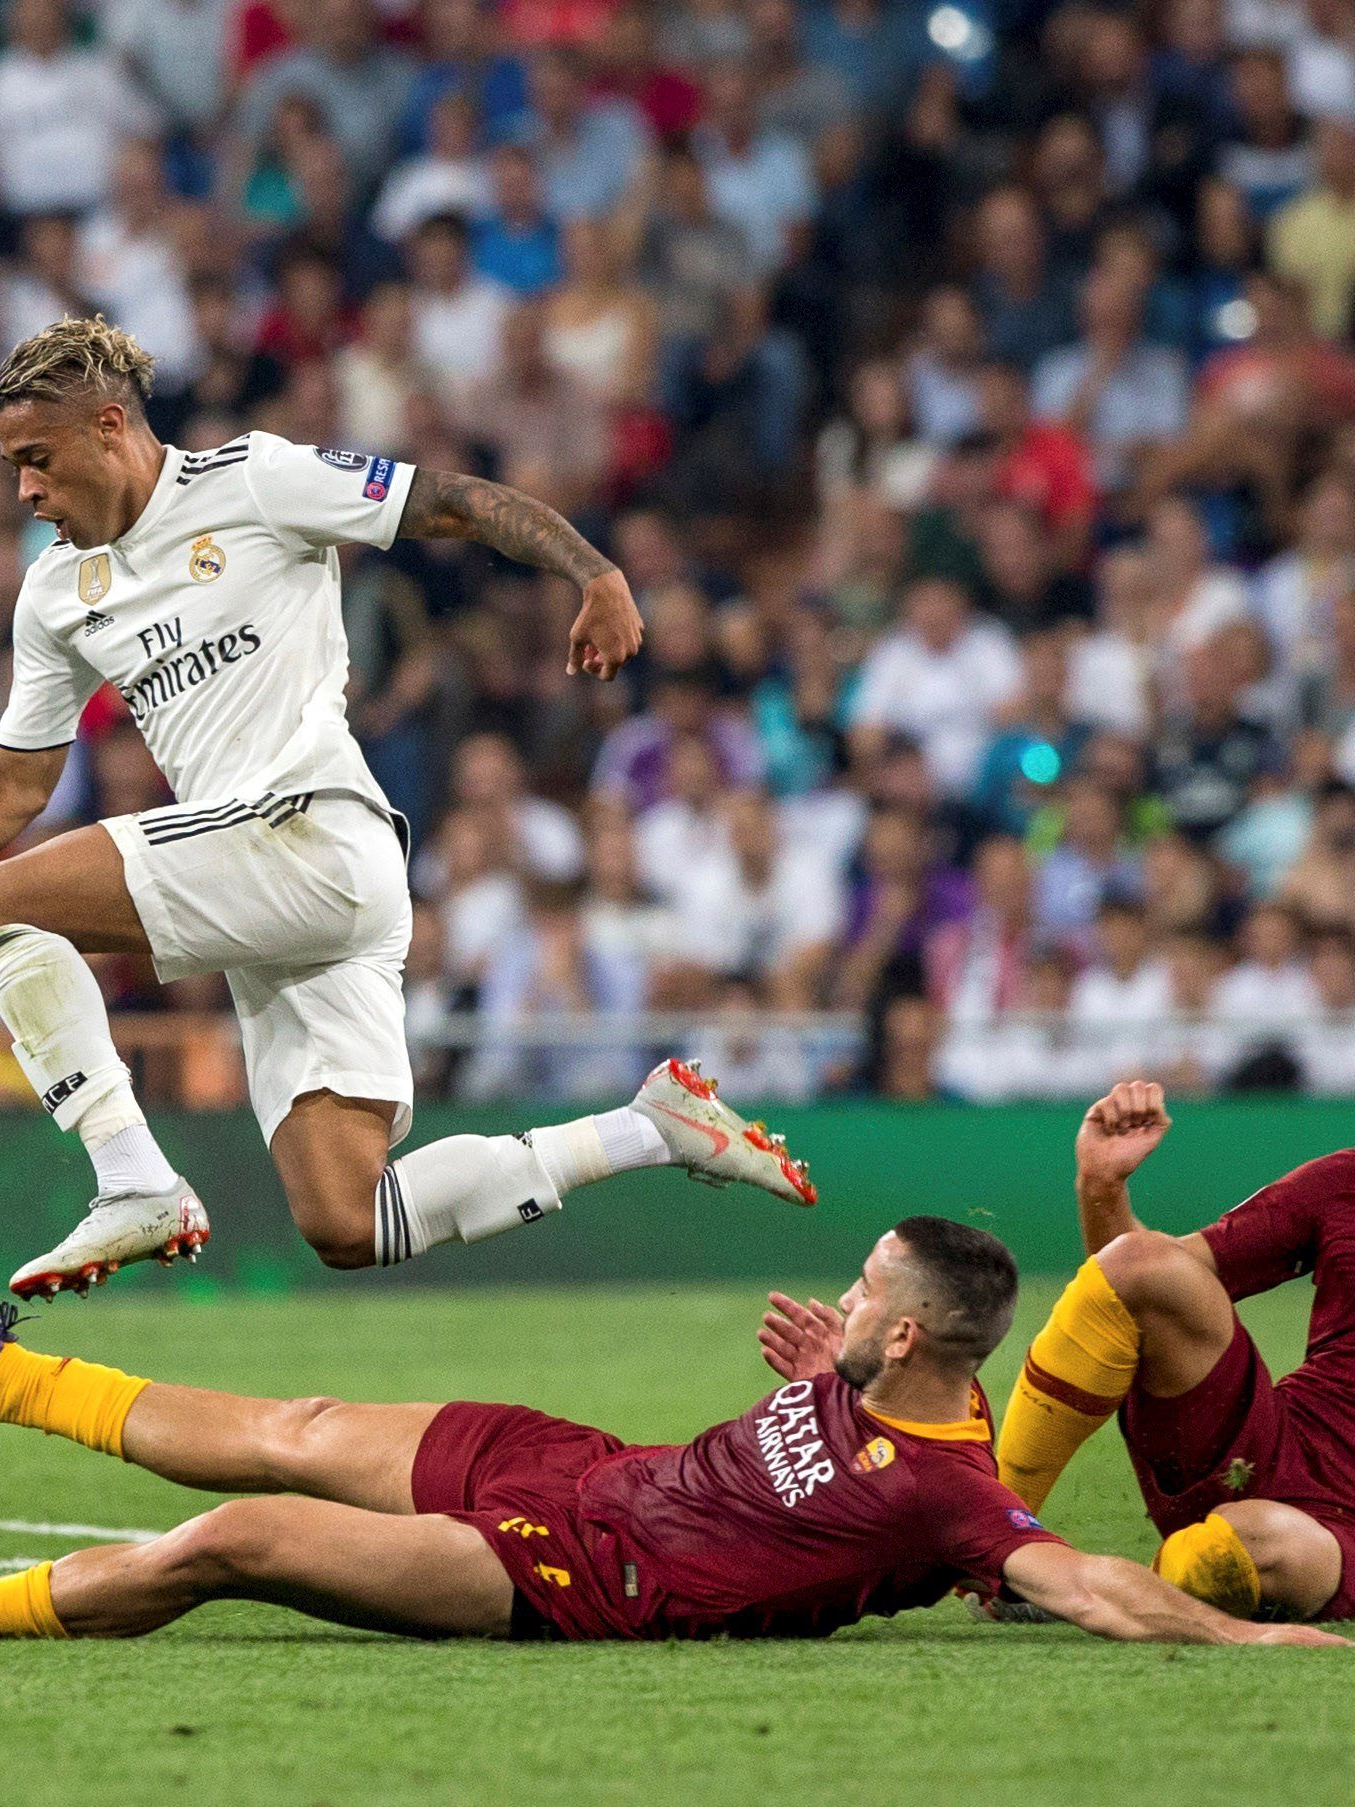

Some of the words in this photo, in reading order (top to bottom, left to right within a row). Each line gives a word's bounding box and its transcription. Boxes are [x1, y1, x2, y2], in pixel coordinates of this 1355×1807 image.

[85, 616, 115, 637] adidas
[119, 624, 261, 721] Emirates
[137, 617, 182, 659] Fly
[754, 1415, 805, 1508] AIRWAYS
[768, 1380, 835, 1496] QATAR
